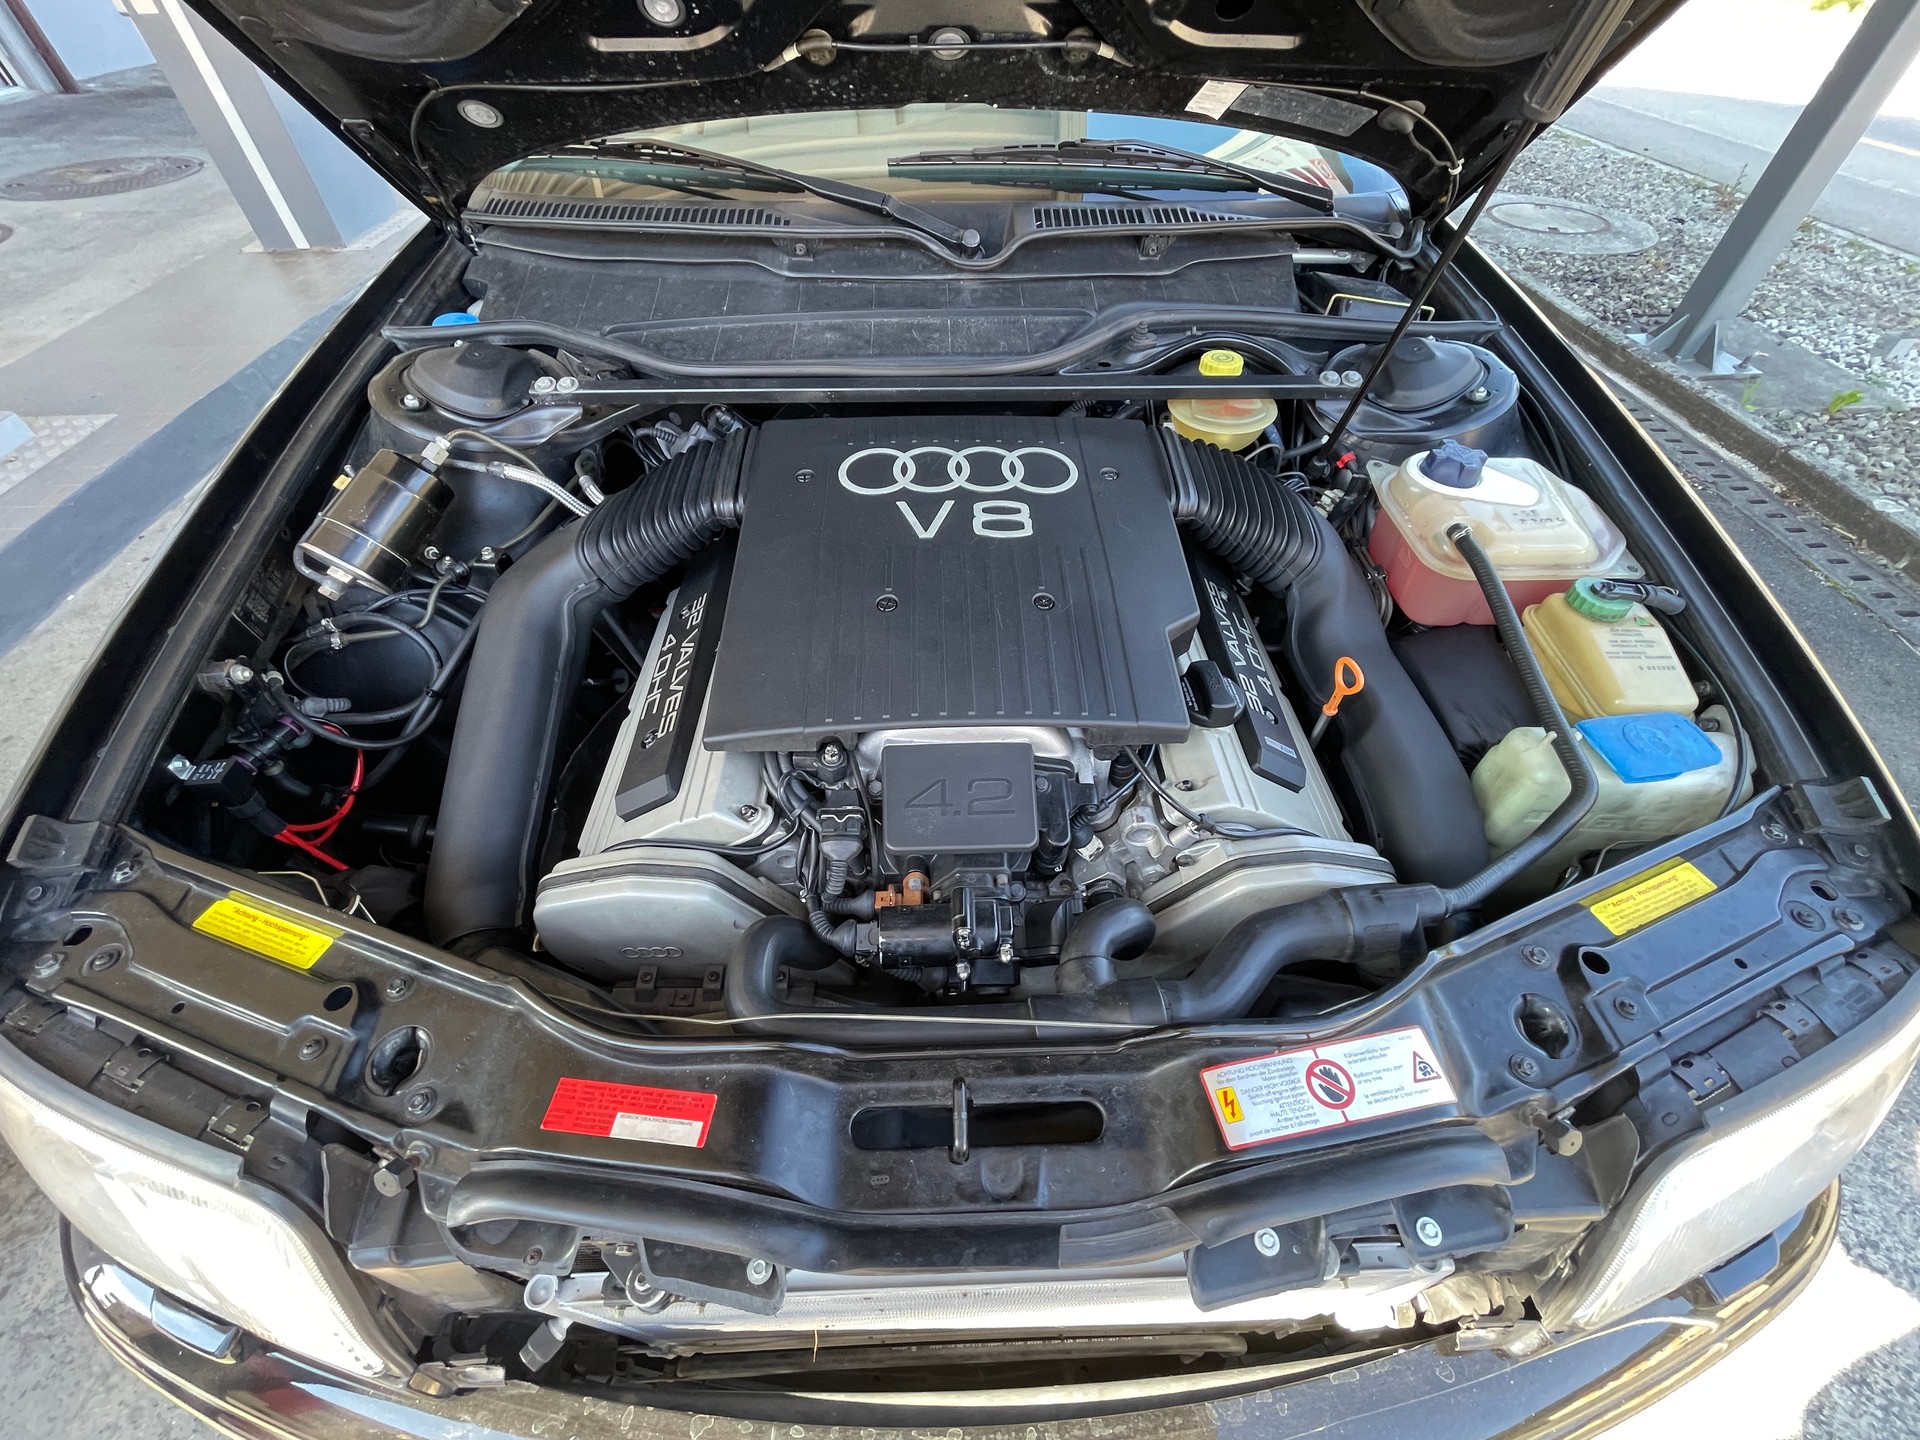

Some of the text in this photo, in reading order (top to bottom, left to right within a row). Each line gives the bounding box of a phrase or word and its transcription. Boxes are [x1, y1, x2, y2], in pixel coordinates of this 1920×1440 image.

[896, 500, 1033, 538] V8
[1204, 578, 1246, 667] VALVES
[1232, 611, 1266, 673] OHC
[641, 633, 677, 721] 4 OHC
[656, 593, 707, 739] 32 VALVES
[1257, 674, 1274, 697] 4
[1238, 673, 1266, 716] 32
[905, 778, 1015, 816] 4.2
[1240, 1086, 1264, 1094] DANGER
